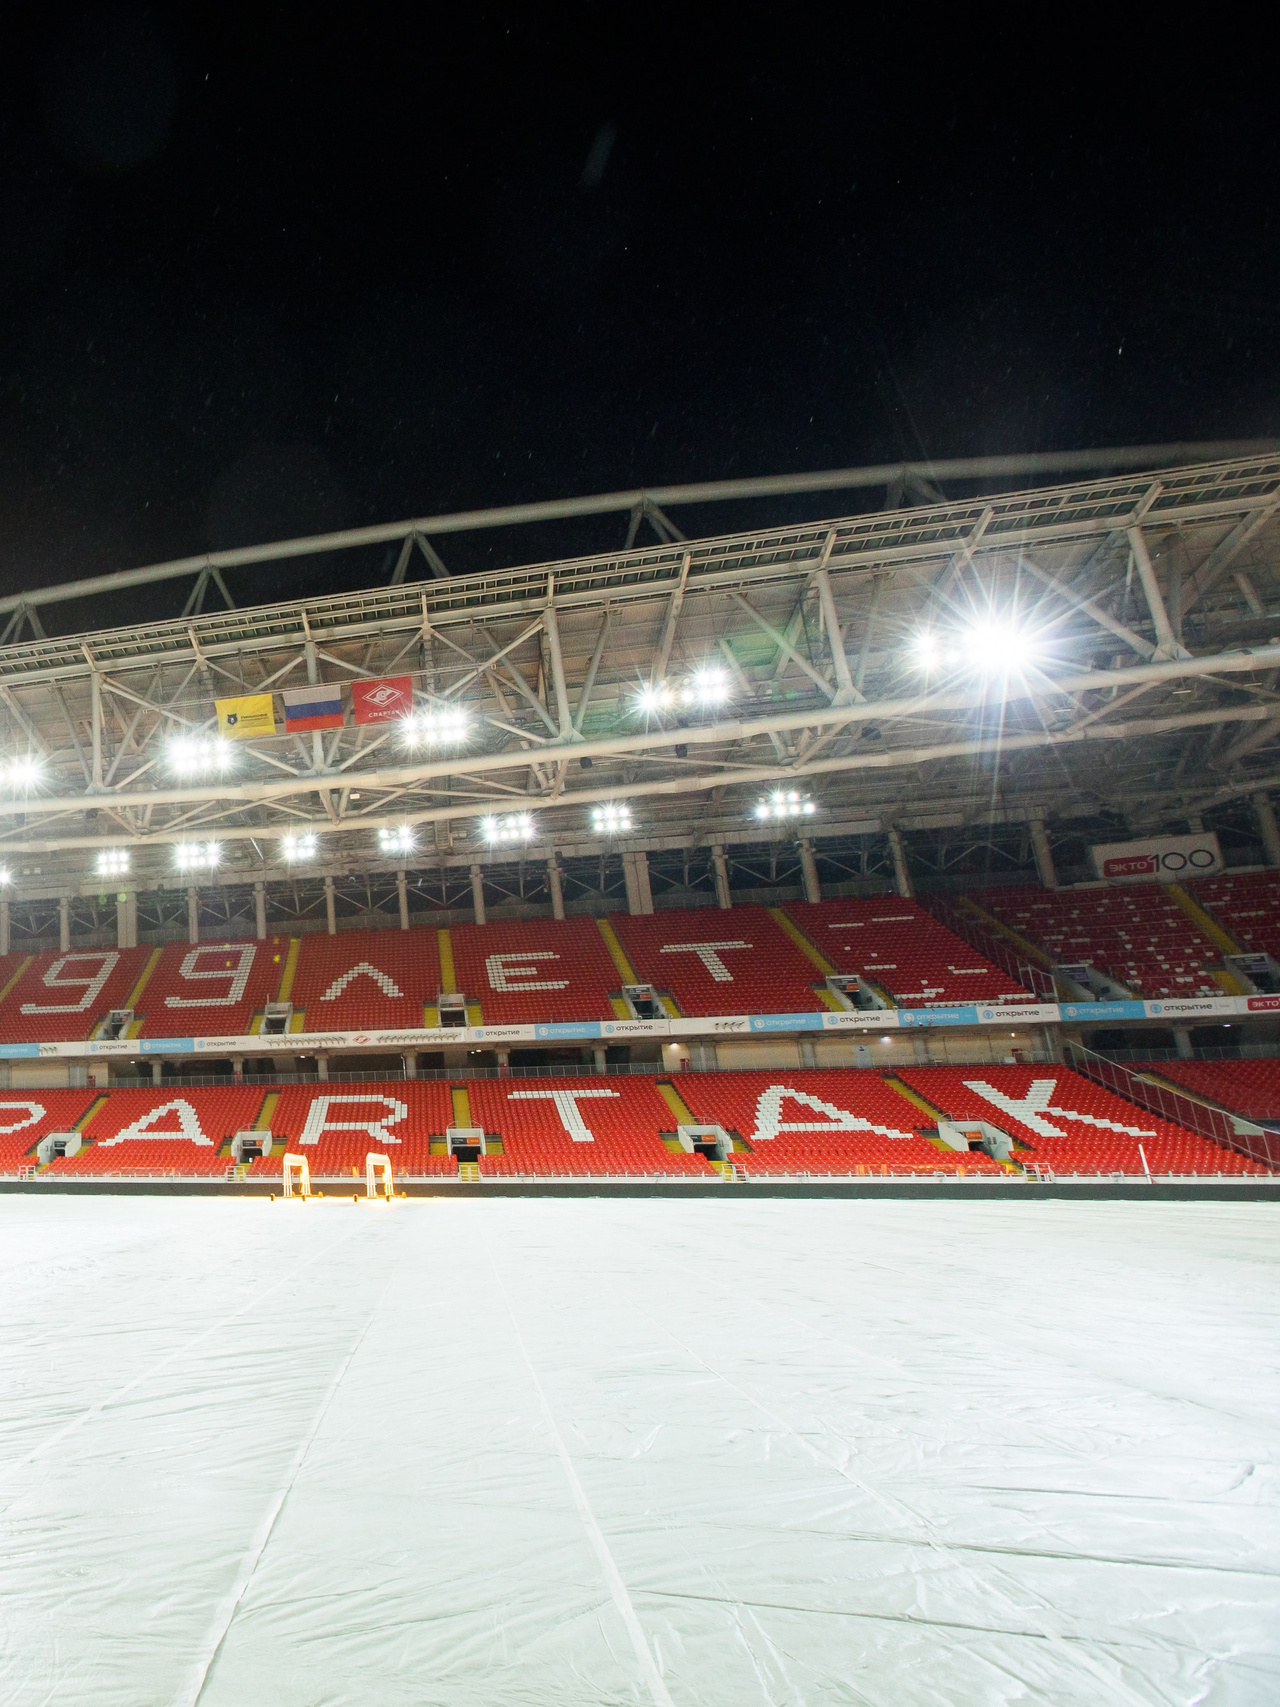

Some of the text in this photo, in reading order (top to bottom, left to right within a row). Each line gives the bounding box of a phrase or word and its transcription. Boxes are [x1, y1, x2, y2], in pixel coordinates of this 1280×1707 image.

[1148, 849, 1215, 873] 100
[1163, 1002, 1213, 1012] открытие
[995, 1008, 1040, 1018] открытие
[839, 1015, 880, 1024] открытие
[485, 1029, 520, 1037] открытие
[615, 1023, 653, 1033] открытие
